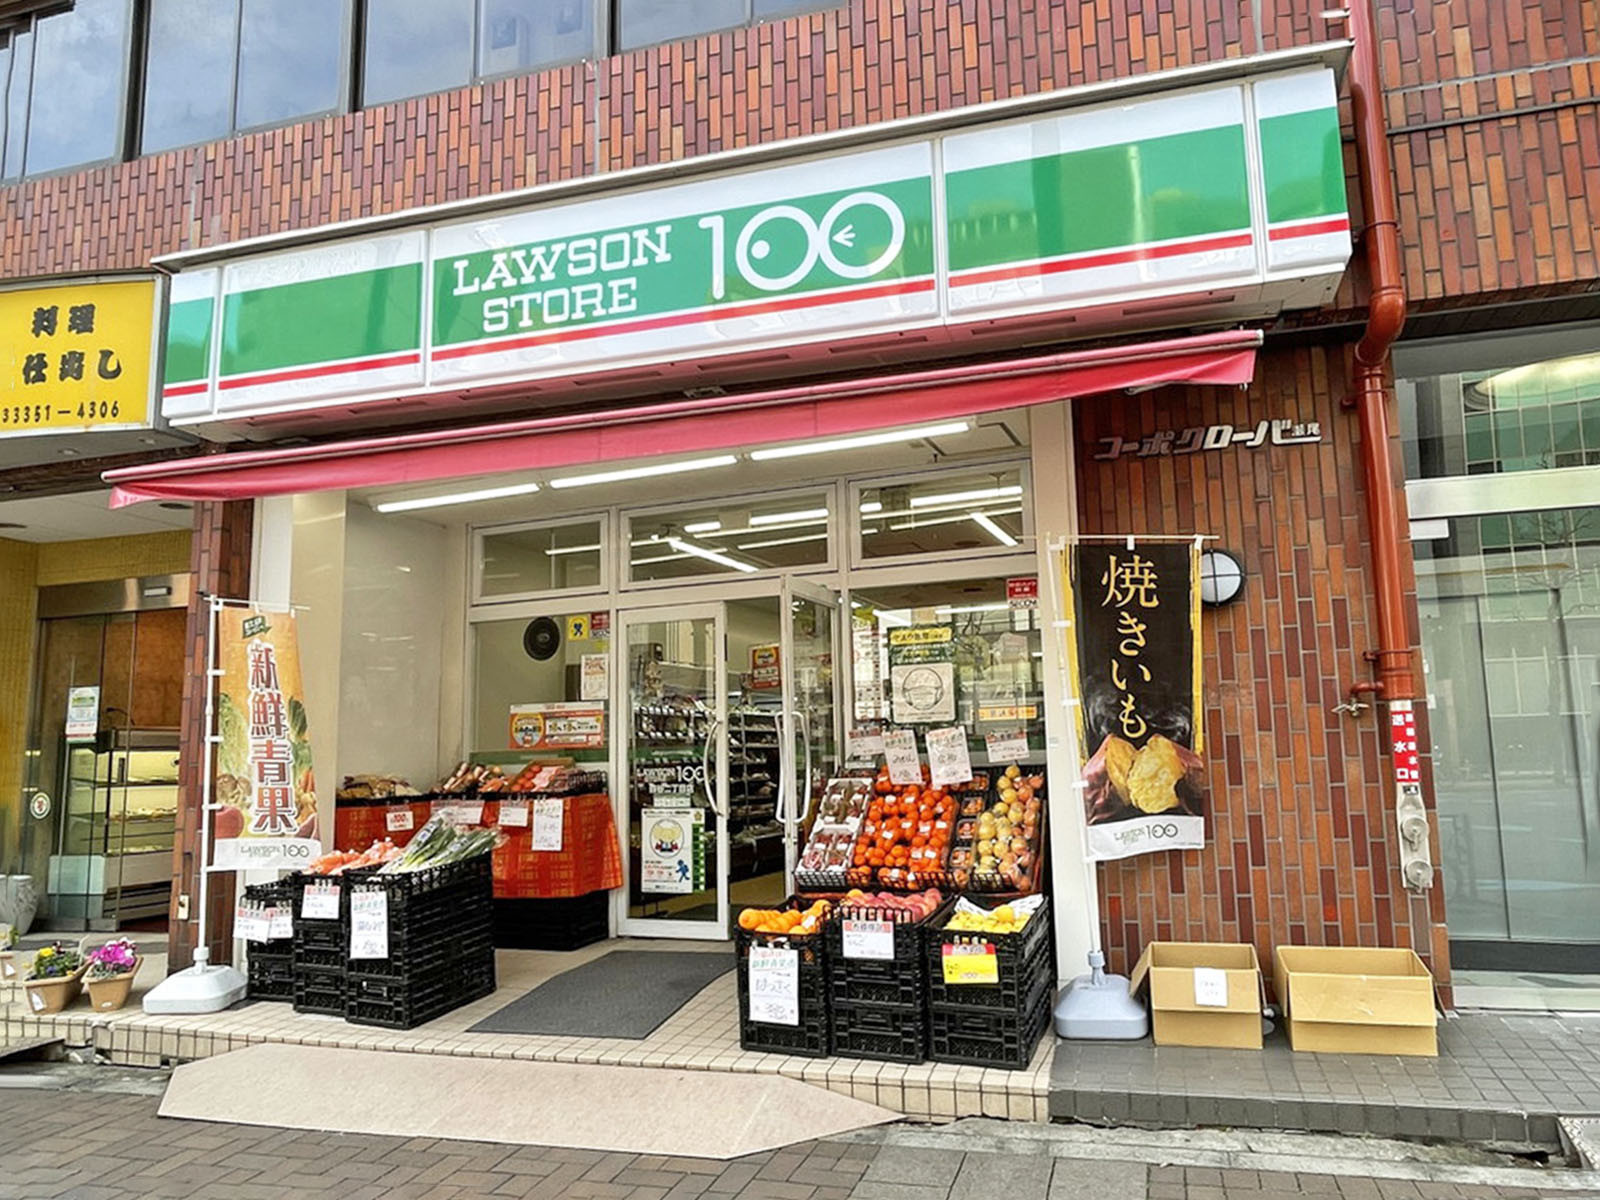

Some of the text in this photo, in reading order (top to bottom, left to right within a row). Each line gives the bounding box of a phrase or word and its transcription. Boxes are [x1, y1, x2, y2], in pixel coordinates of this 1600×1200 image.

[452, 225, 672, 296] LAWSON
[698, 191, 906, 300] 100
[31, 303, 96, 338] 料理
[482, 277, 637, 333] STORE
[22, 349, 122, 385] 仕出し
[1101, 554, 1160, 738] 焼きいも
[249, 641, 296, 832] 新鮮青果
[281, 844, 310, 858] 100
[1145, 823, 1178, 839] 100
